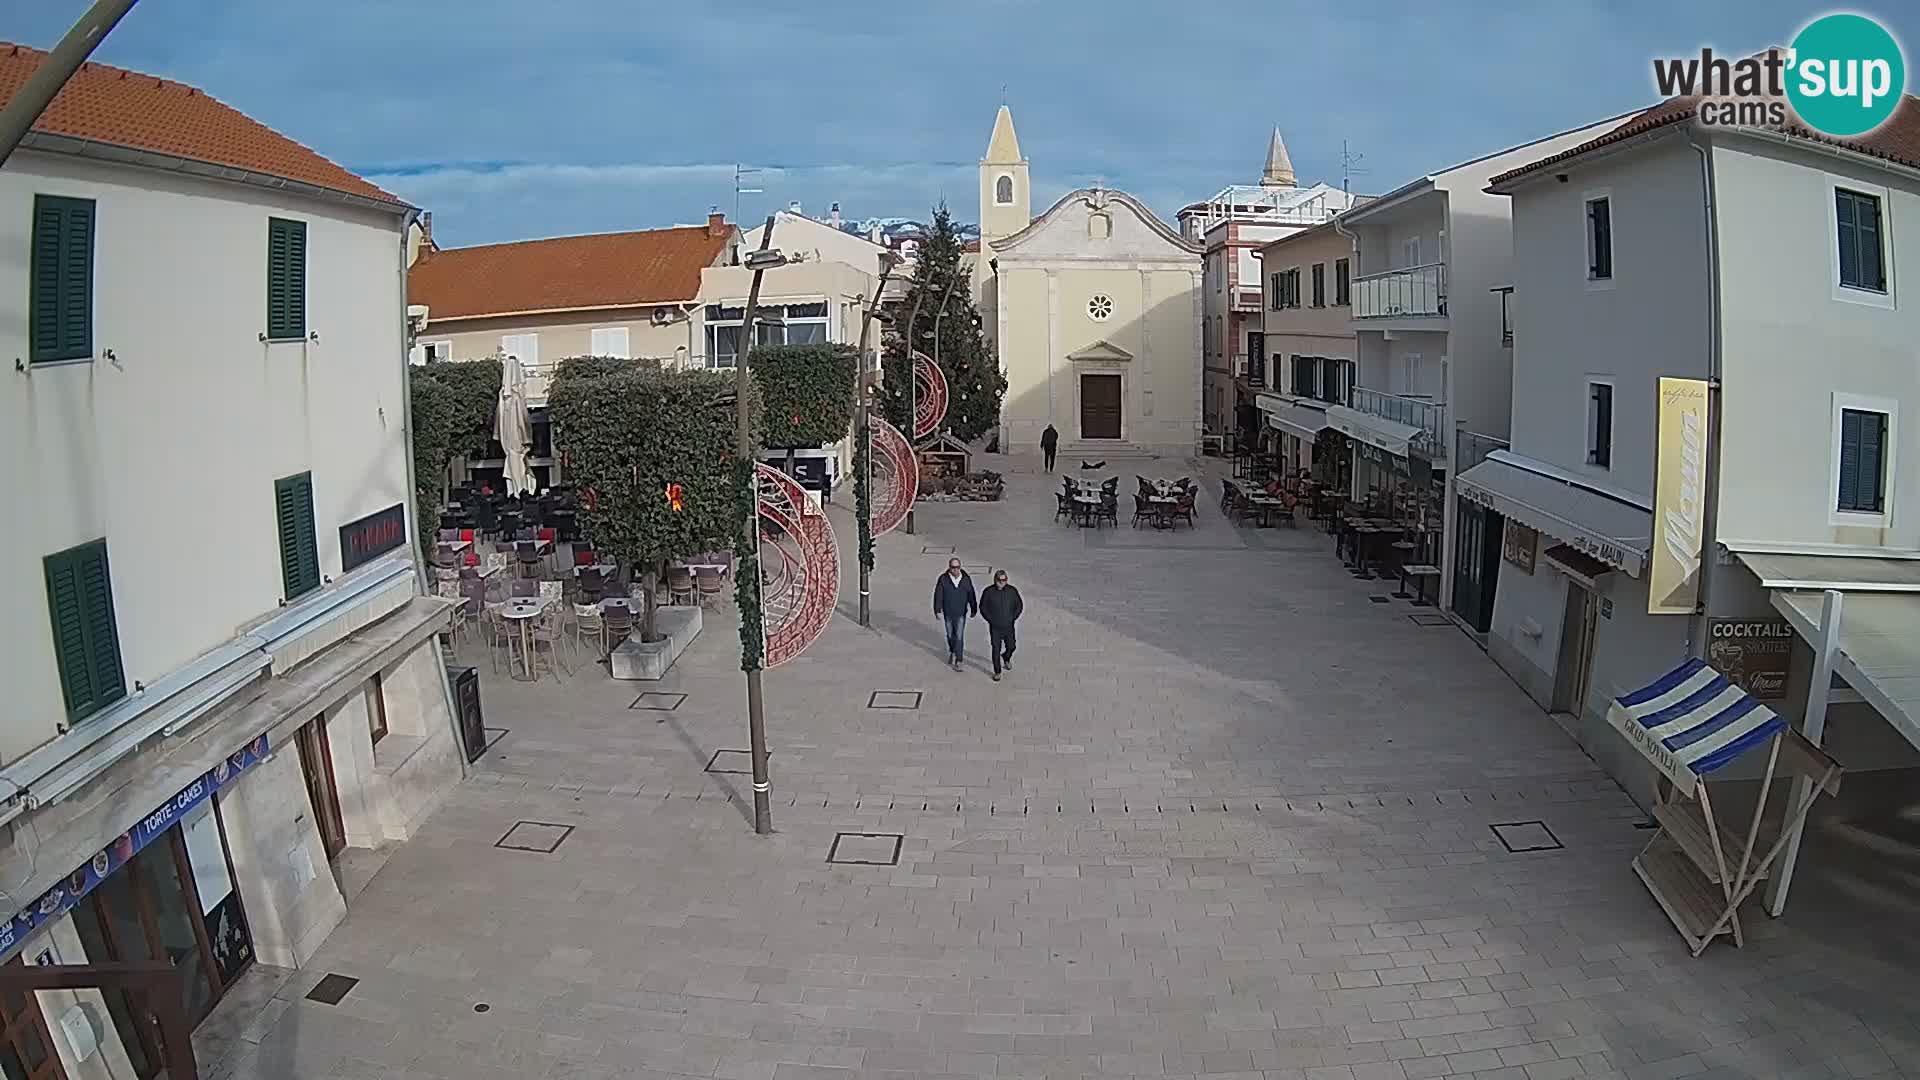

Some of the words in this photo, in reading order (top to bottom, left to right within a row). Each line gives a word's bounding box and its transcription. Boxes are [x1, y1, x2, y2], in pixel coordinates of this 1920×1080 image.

[1712, 623, 1793, 638] COCKTAILS
[1624, 718, 1645, 743] GRAD
[143, 803, 172, 834] TORTE
[177, 780, 203, 809] CAKES
